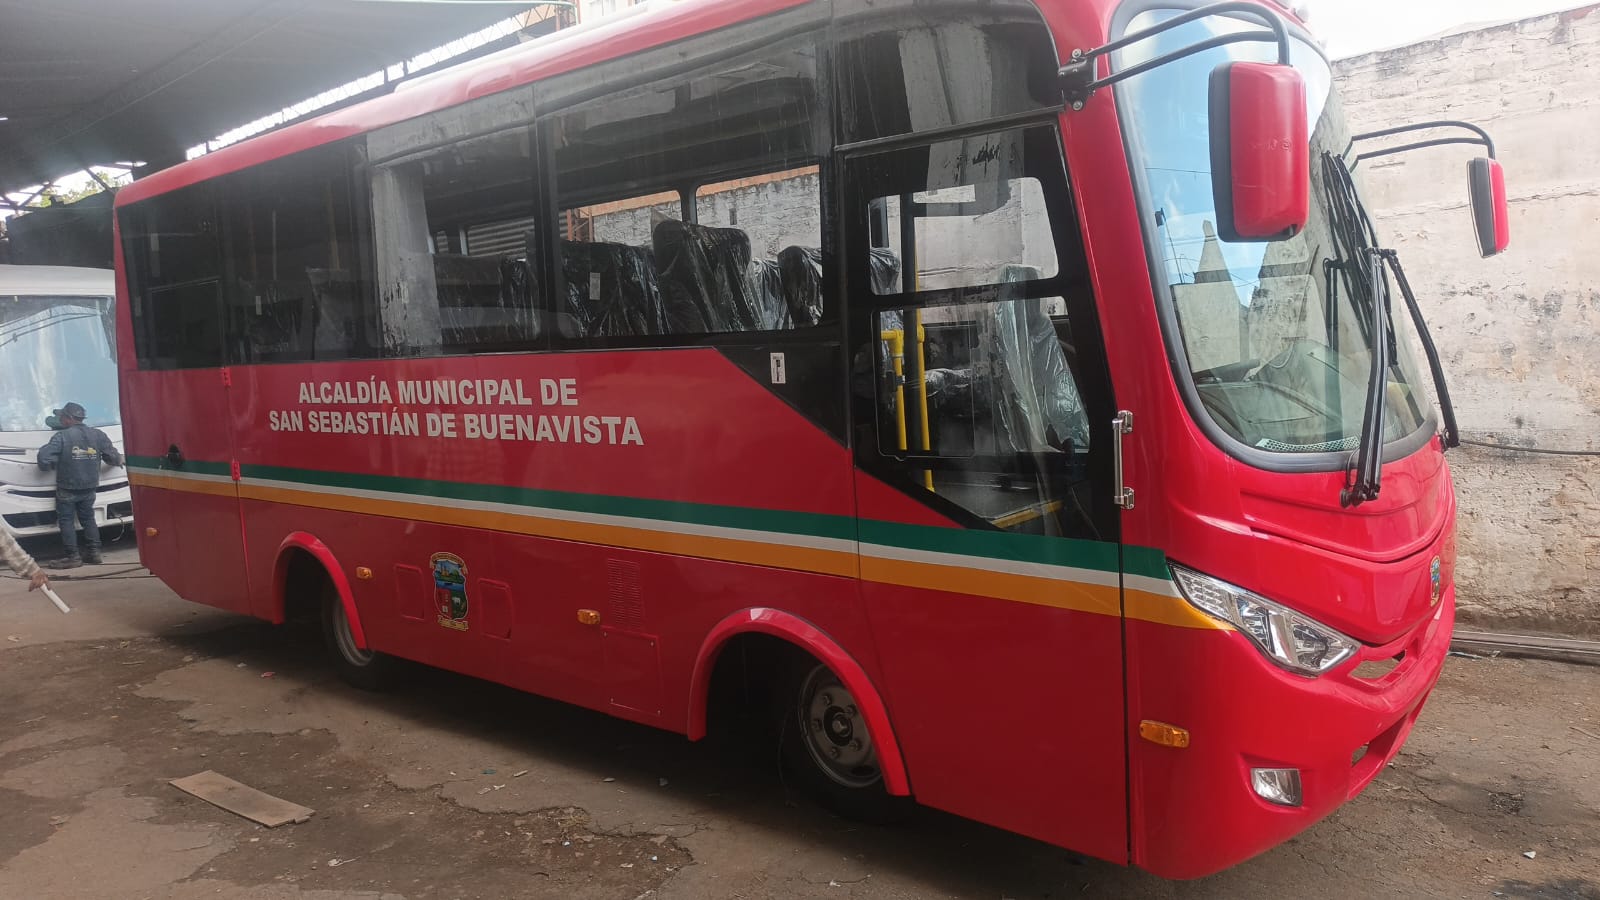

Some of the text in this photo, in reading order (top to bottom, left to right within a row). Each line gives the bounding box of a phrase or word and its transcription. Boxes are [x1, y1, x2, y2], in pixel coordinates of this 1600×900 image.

[298, 375, 579, 406] ALCALDÍA MUNICIPAL DE
[269, 407, 644, 446] SAN SEBASTIÁN DE BUENAVISTA
